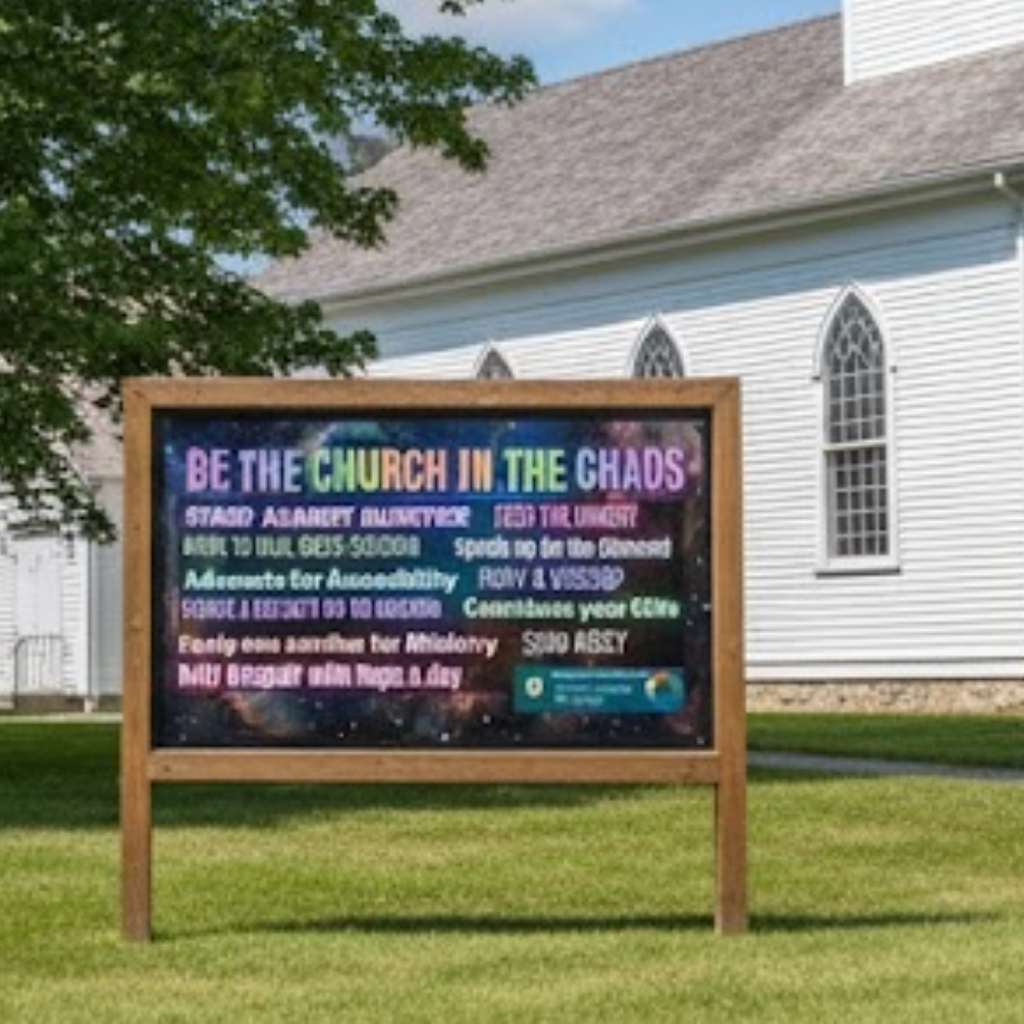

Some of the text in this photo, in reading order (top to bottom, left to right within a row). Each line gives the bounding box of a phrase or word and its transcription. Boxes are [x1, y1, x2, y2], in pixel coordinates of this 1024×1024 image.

[185, 447, 231, 493] BE
[238, 448, 302, 493] THE
[312, 448, 447, 493] CHURCH
[458, 448, 493, 493] IN
[503, 448, 568, 493] THE
